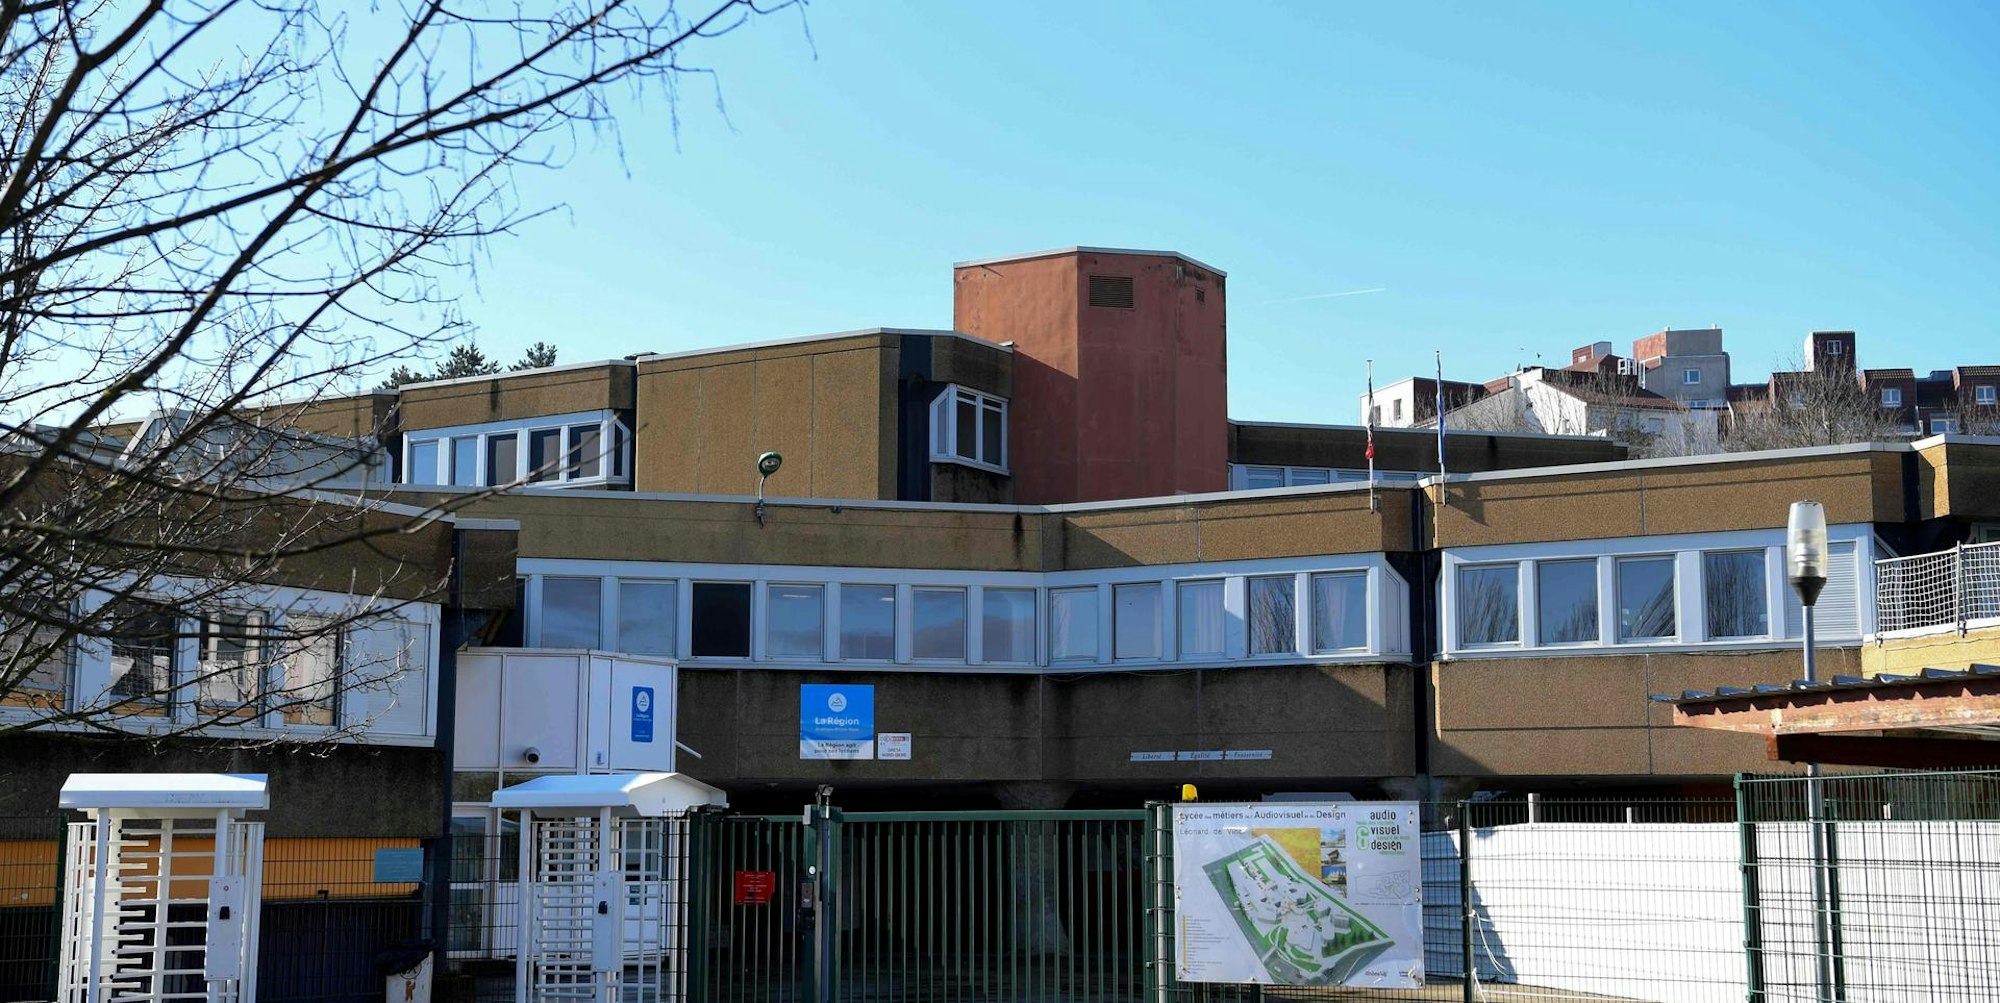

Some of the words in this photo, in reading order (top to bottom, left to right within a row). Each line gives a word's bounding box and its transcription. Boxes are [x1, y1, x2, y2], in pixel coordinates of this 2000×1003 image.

[815, 716, 826, 725] La
[827, 715, 860, 726] Région
[1179, 811, 1204, 821] Lycée
[1212, 811, 1244, 820] métiers
[1254, 811, 1304, 819] Audiovisuel
[1316, 810, 1346, 820] Design
[1370, 810, 1397, 821] audio
[1370, 825, 1400, 836] visuel
[1370, 839, 1402, 852] design
